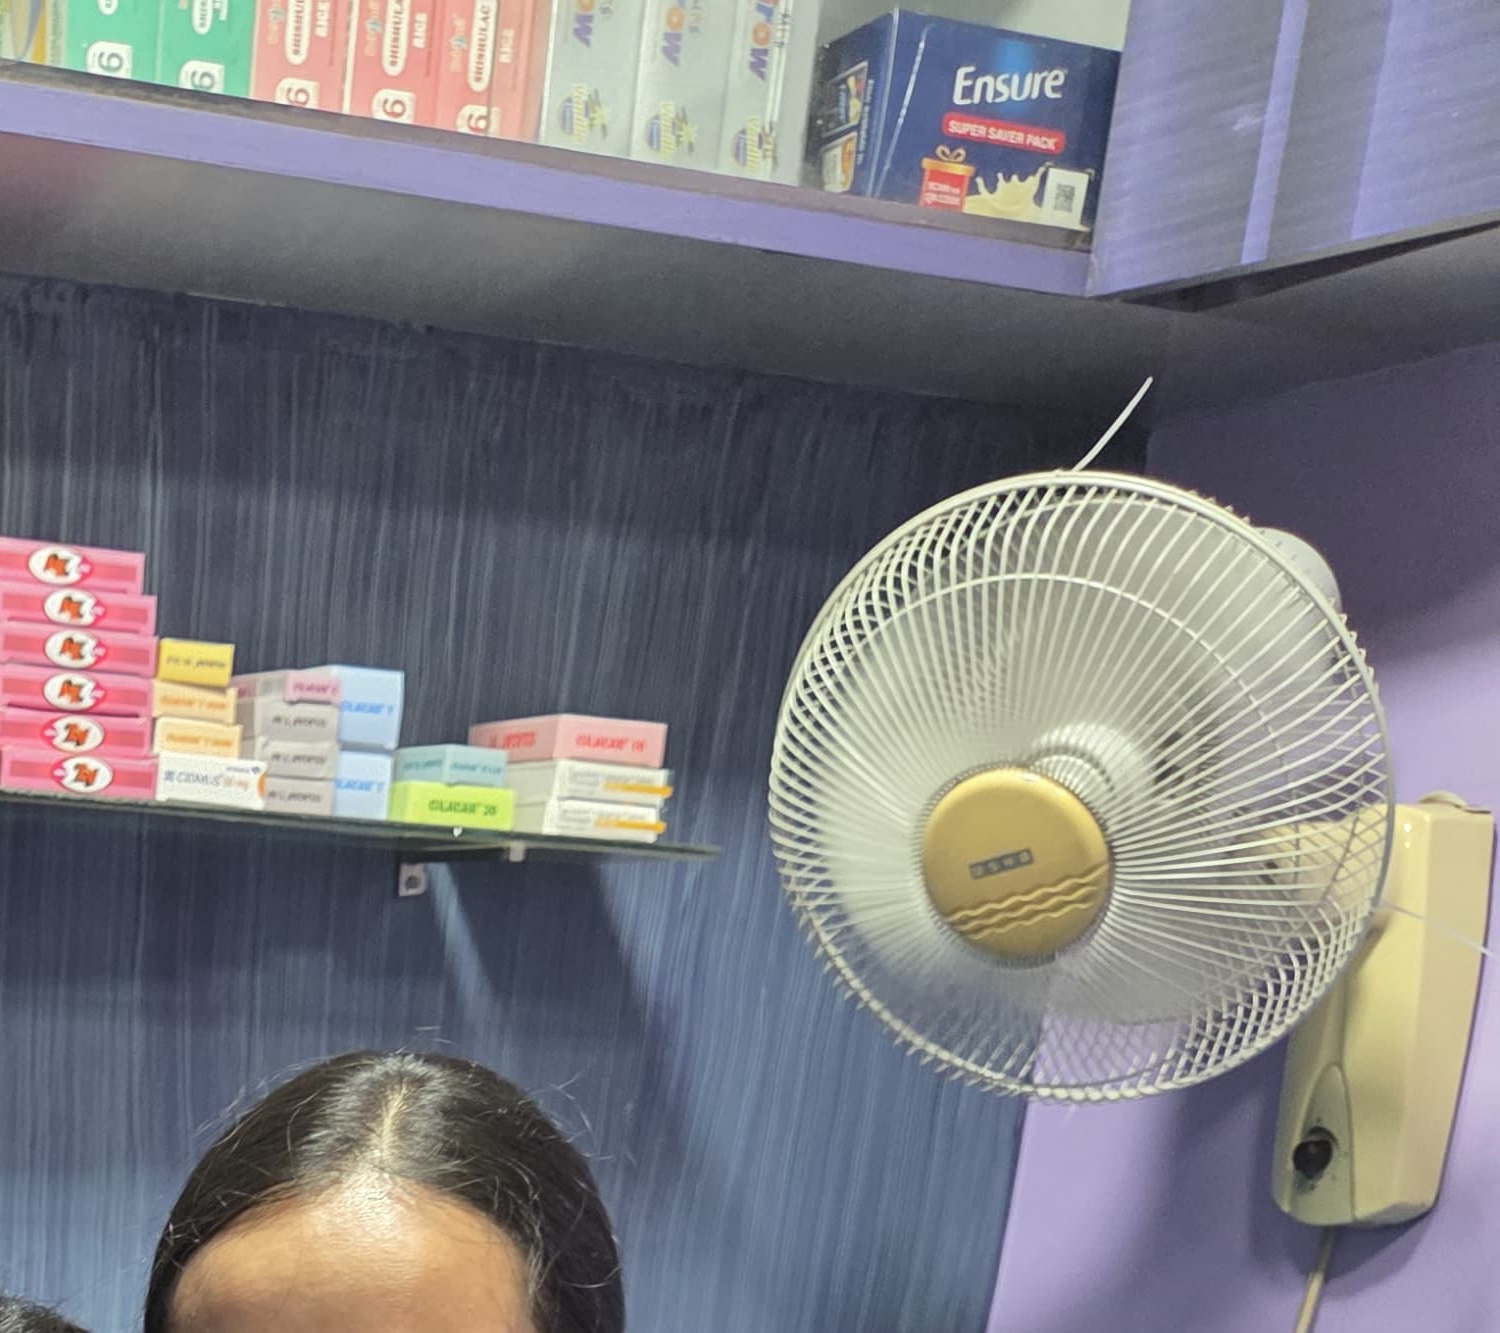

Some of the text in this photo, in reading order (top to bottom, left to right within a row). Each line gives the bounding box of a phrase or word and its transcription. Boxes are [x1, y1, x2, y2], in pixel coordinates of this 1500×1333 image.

[412, 12, 428, 49] RICE
[97, 51, 124, 72] 6
[190, 71, 216, 91] 6
[952, 65, 1066, 106] Ensure
[286, 87, 310, 107] 6
[382, 98, 406, 119] 6
[948, 120, 1058, 150] SUPER SAVER PACK
